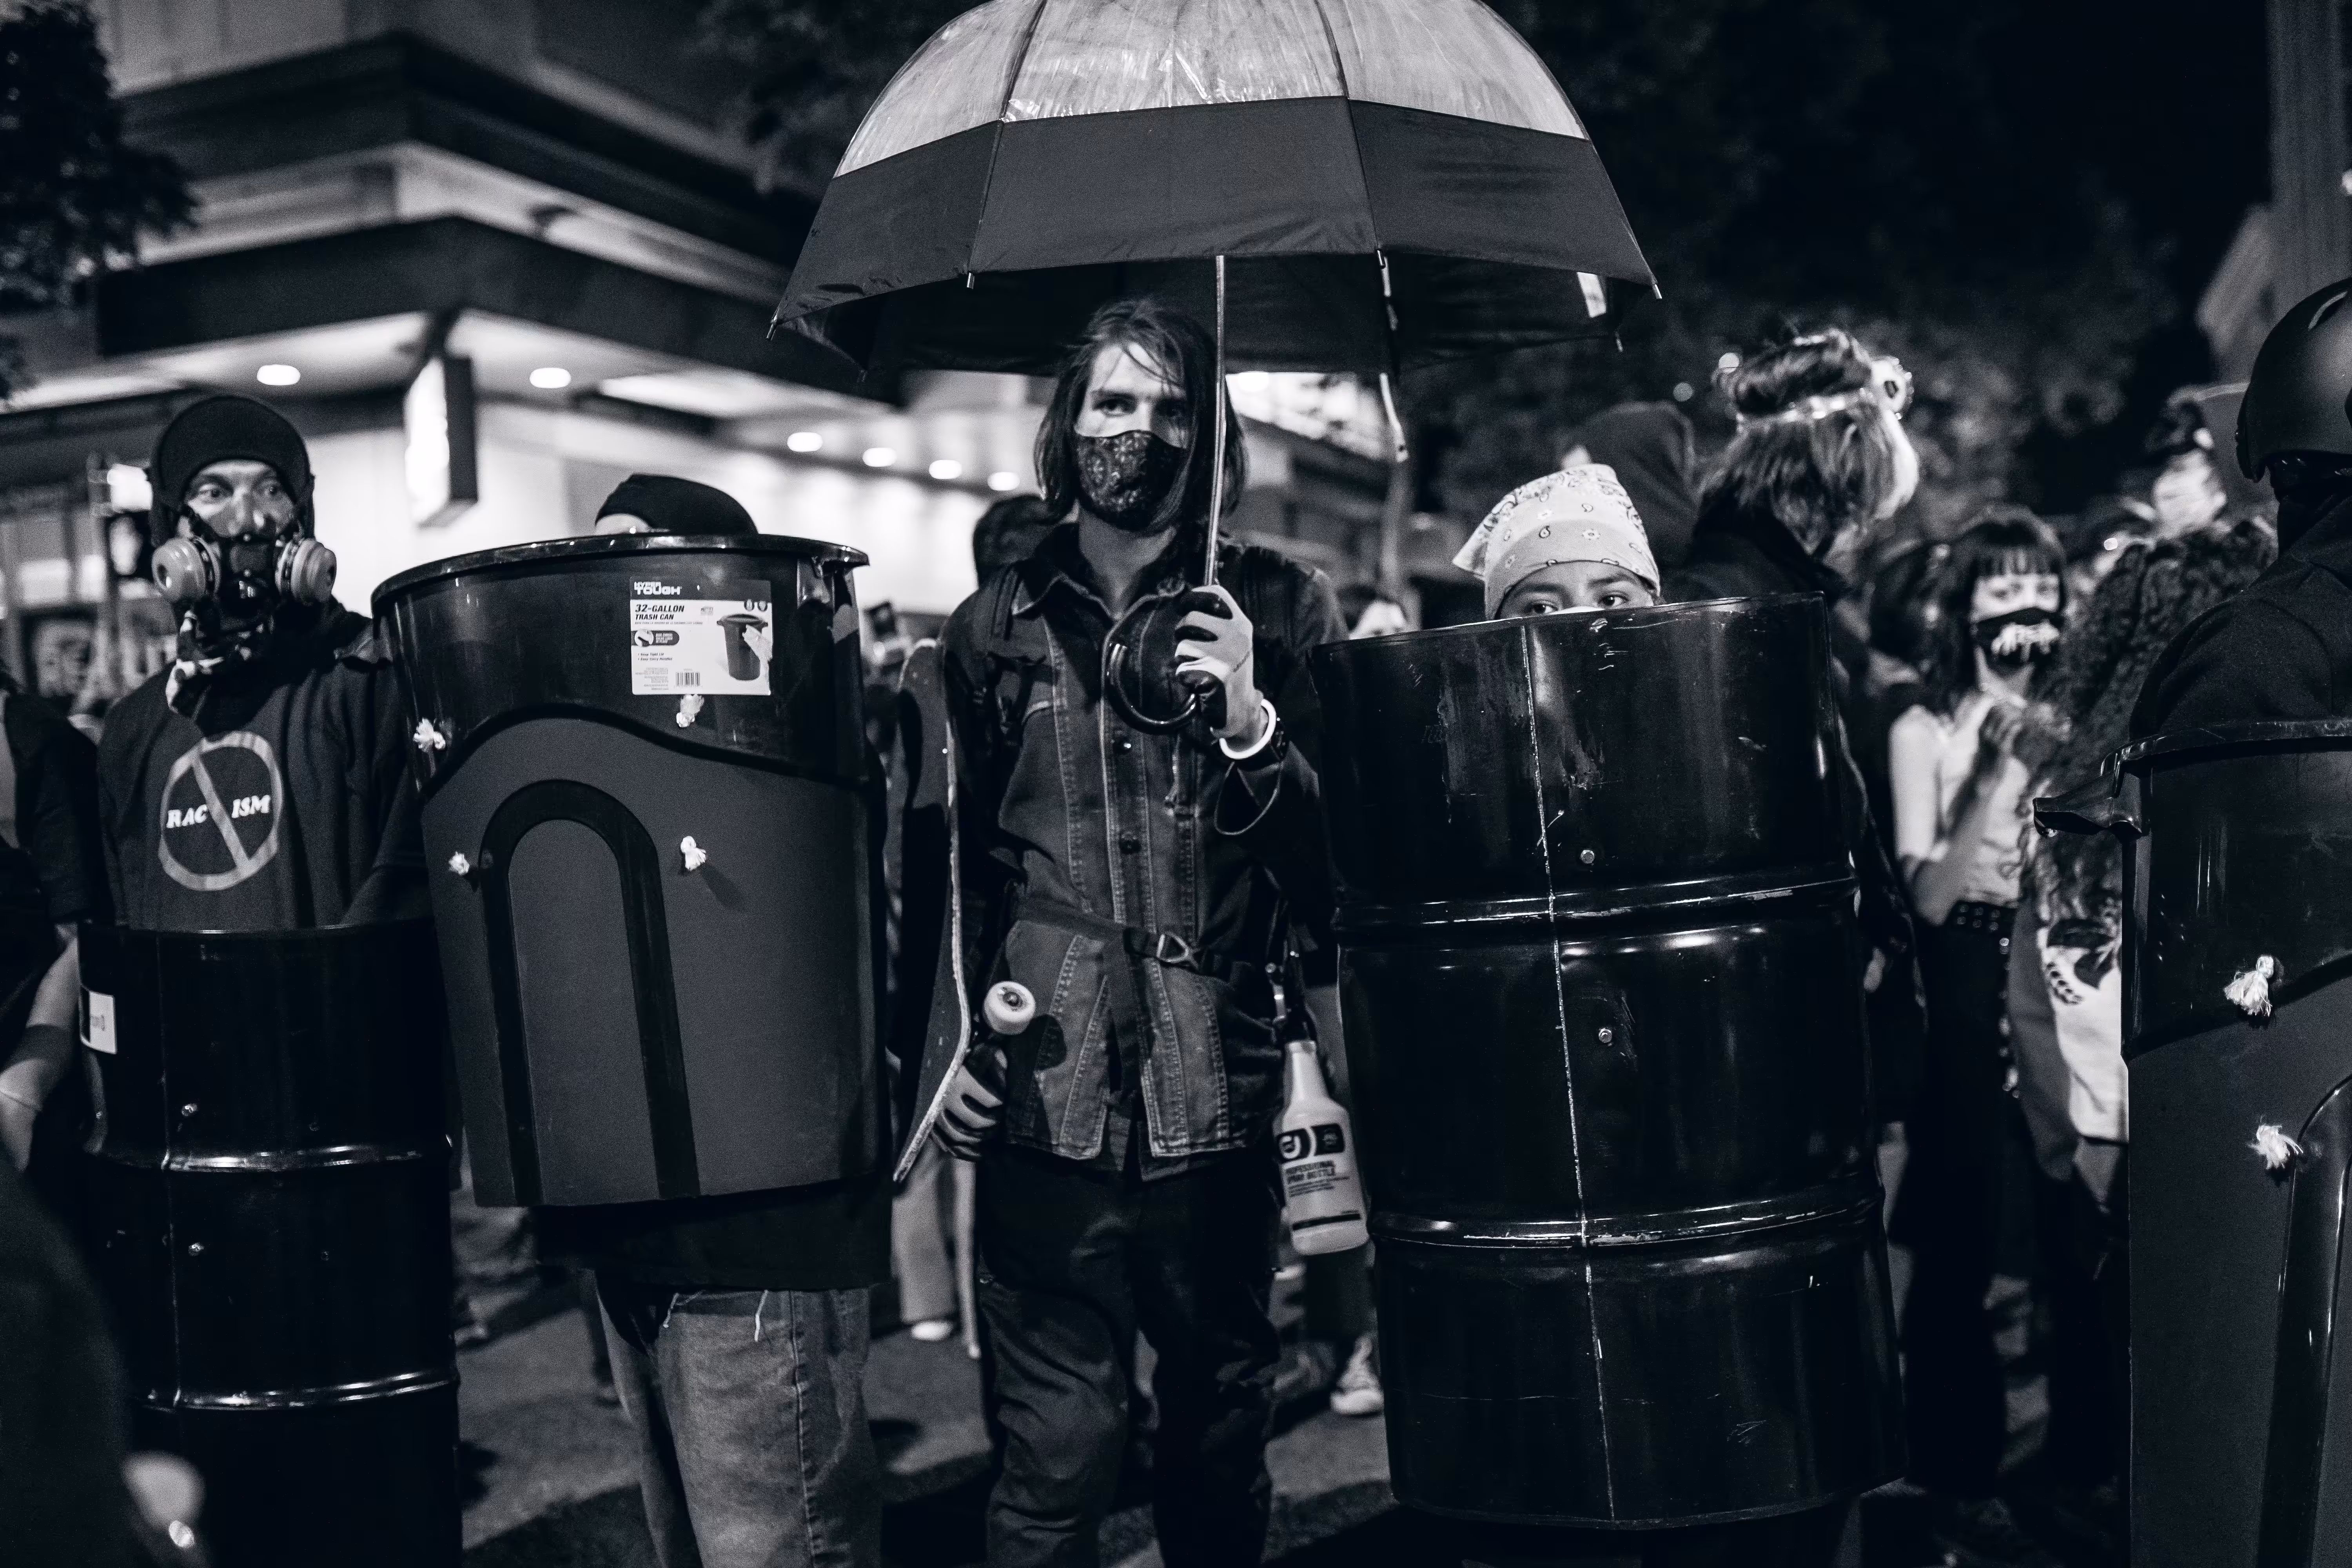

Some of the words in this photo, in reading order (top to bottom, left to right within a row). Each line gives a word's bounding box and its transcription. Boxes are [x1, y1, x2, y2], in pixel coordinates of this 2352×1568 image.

[634, 581, 662, 590] HYPER
[634, 586, 681, 595] TOUGH
[635, 604, 684, 612] 32-GALLON
[167, 804, 208, 828] RAC
[232, 795, 270, 818] ISM
